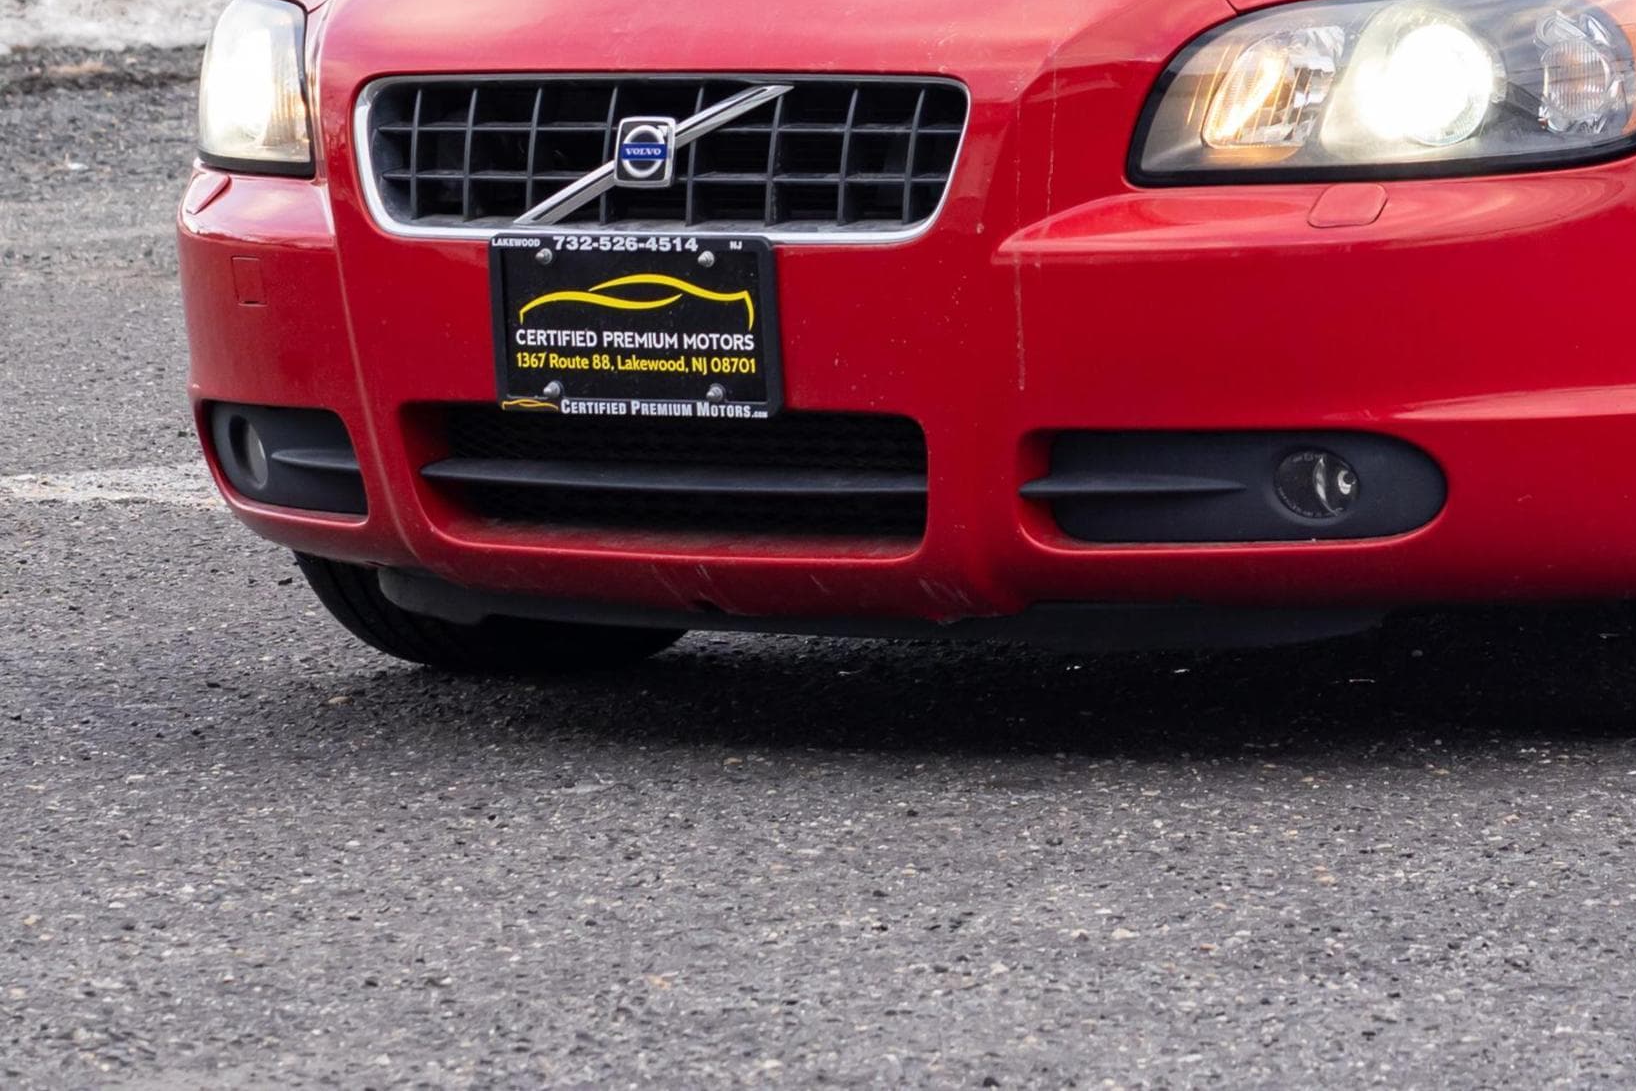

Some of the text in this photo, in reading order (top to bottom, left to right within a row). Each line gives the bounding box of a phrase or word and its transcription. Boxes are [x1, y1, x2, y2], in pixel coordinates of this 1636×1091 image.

[625, 147, 662, 156] VOLVO
[491, 236, 743, 252] LAKEWOOD 732-526-4514 NJ
[515, 329, 755, 350] CERTIFIED PREMIUM MOTORS
[516, 352, 756, 375] 1367 Route 88, Lakewood, NJ 08701
